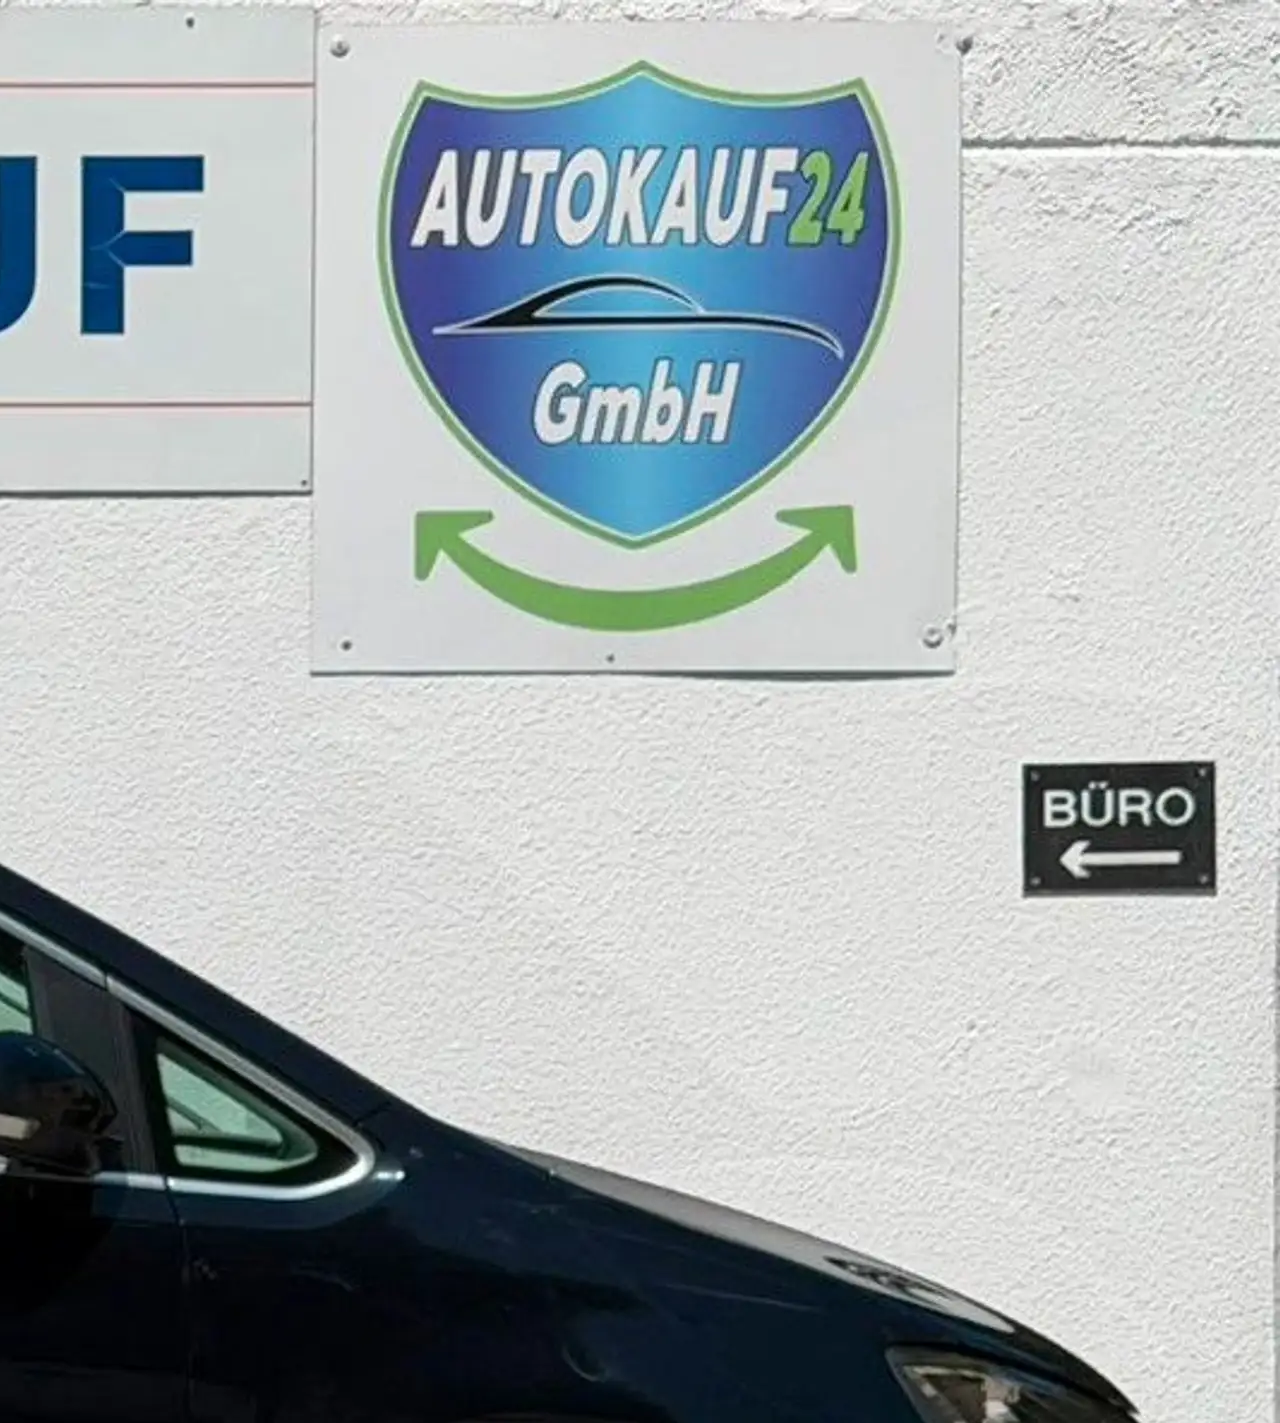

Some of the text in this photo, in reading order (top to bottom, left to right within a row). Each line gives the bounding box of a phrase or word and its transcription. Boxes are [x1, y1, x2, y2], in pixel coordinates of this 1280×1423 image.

[410, 147, 868, 247] AUTOKAUF24
[533, 359, 740, 445] GmbH
[1042, 780, 1196, 828] BÜRO
